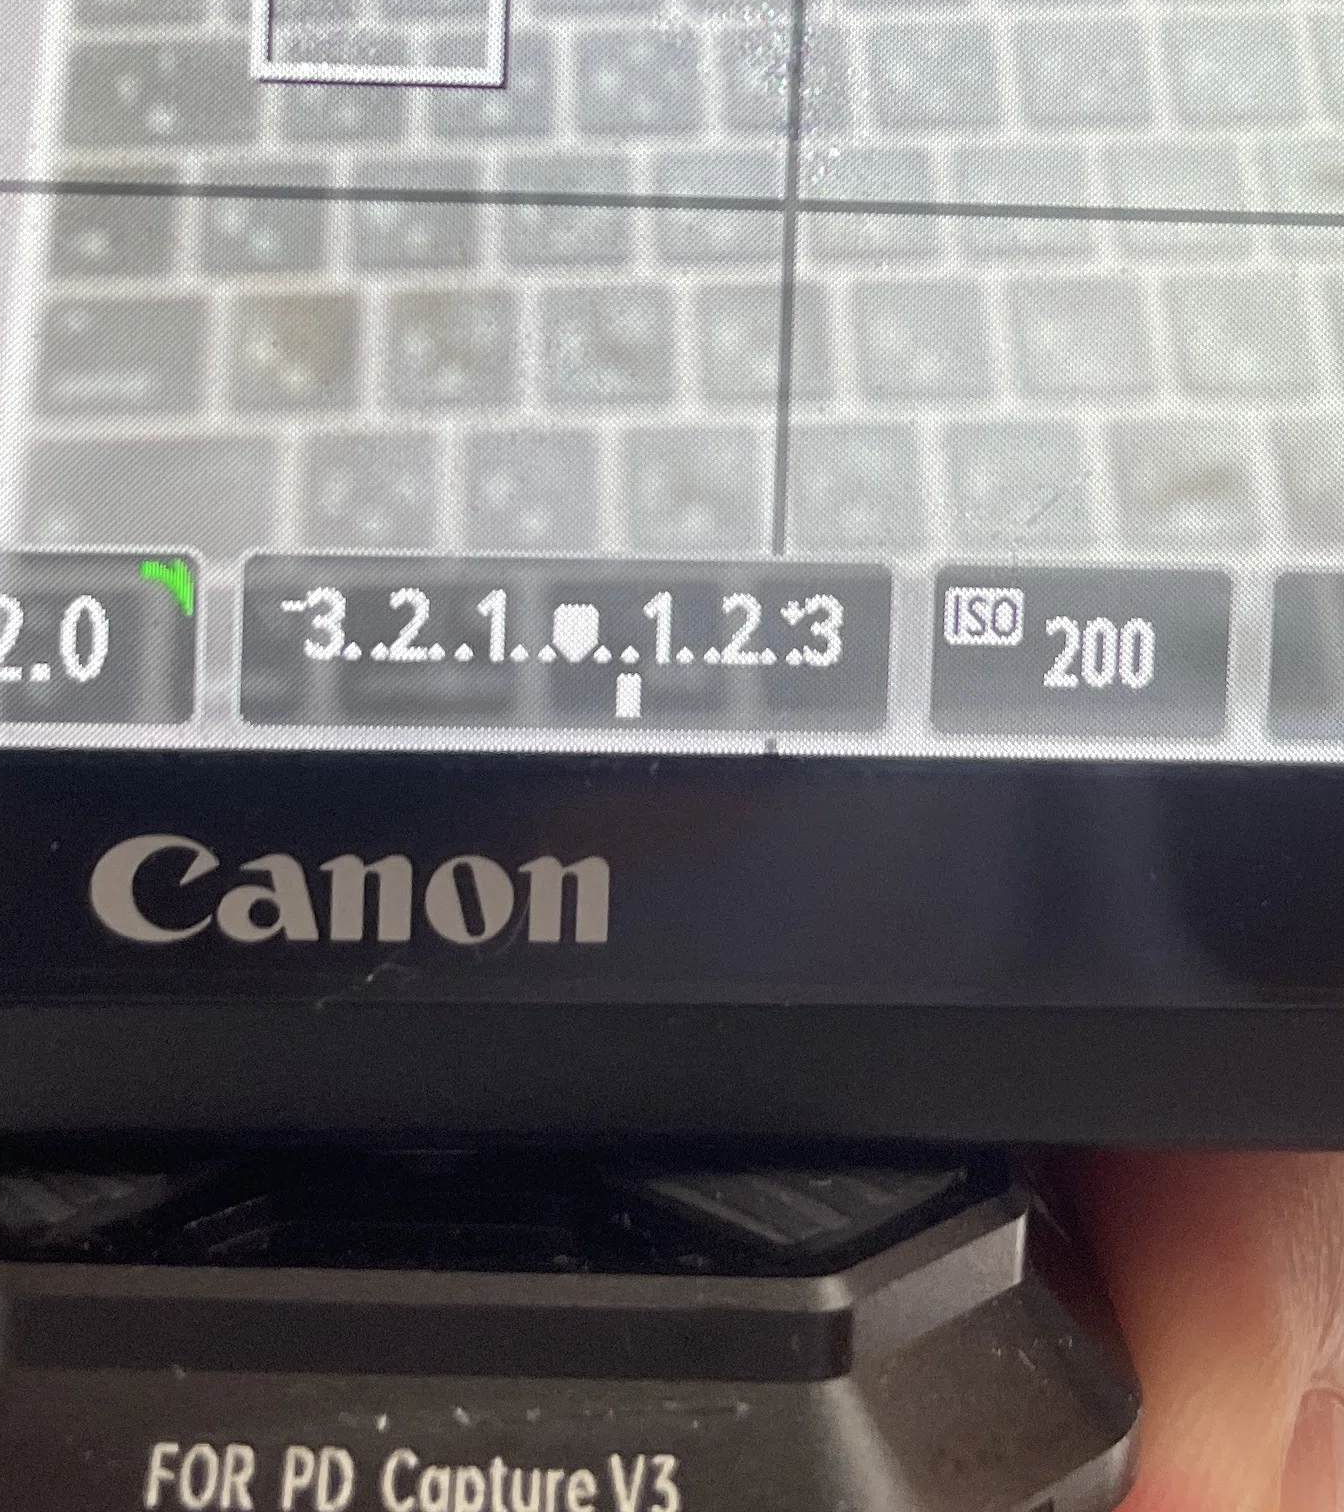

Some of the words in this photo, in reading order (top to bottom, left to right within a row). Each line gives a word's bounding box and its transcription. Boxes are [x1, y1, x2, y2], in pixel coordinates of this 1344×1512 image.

[954, 593, 1020, 638] ISO
[1043, 616, 1156, 689] 200
[89, 832, 612, 945] Canon
[144, 1441, 256, 1511] FOR
[281, 1444, 355, 1512] PD
[379, 1448, 599, 1512] Capture
[609, 1452, 680, 1512] V3
